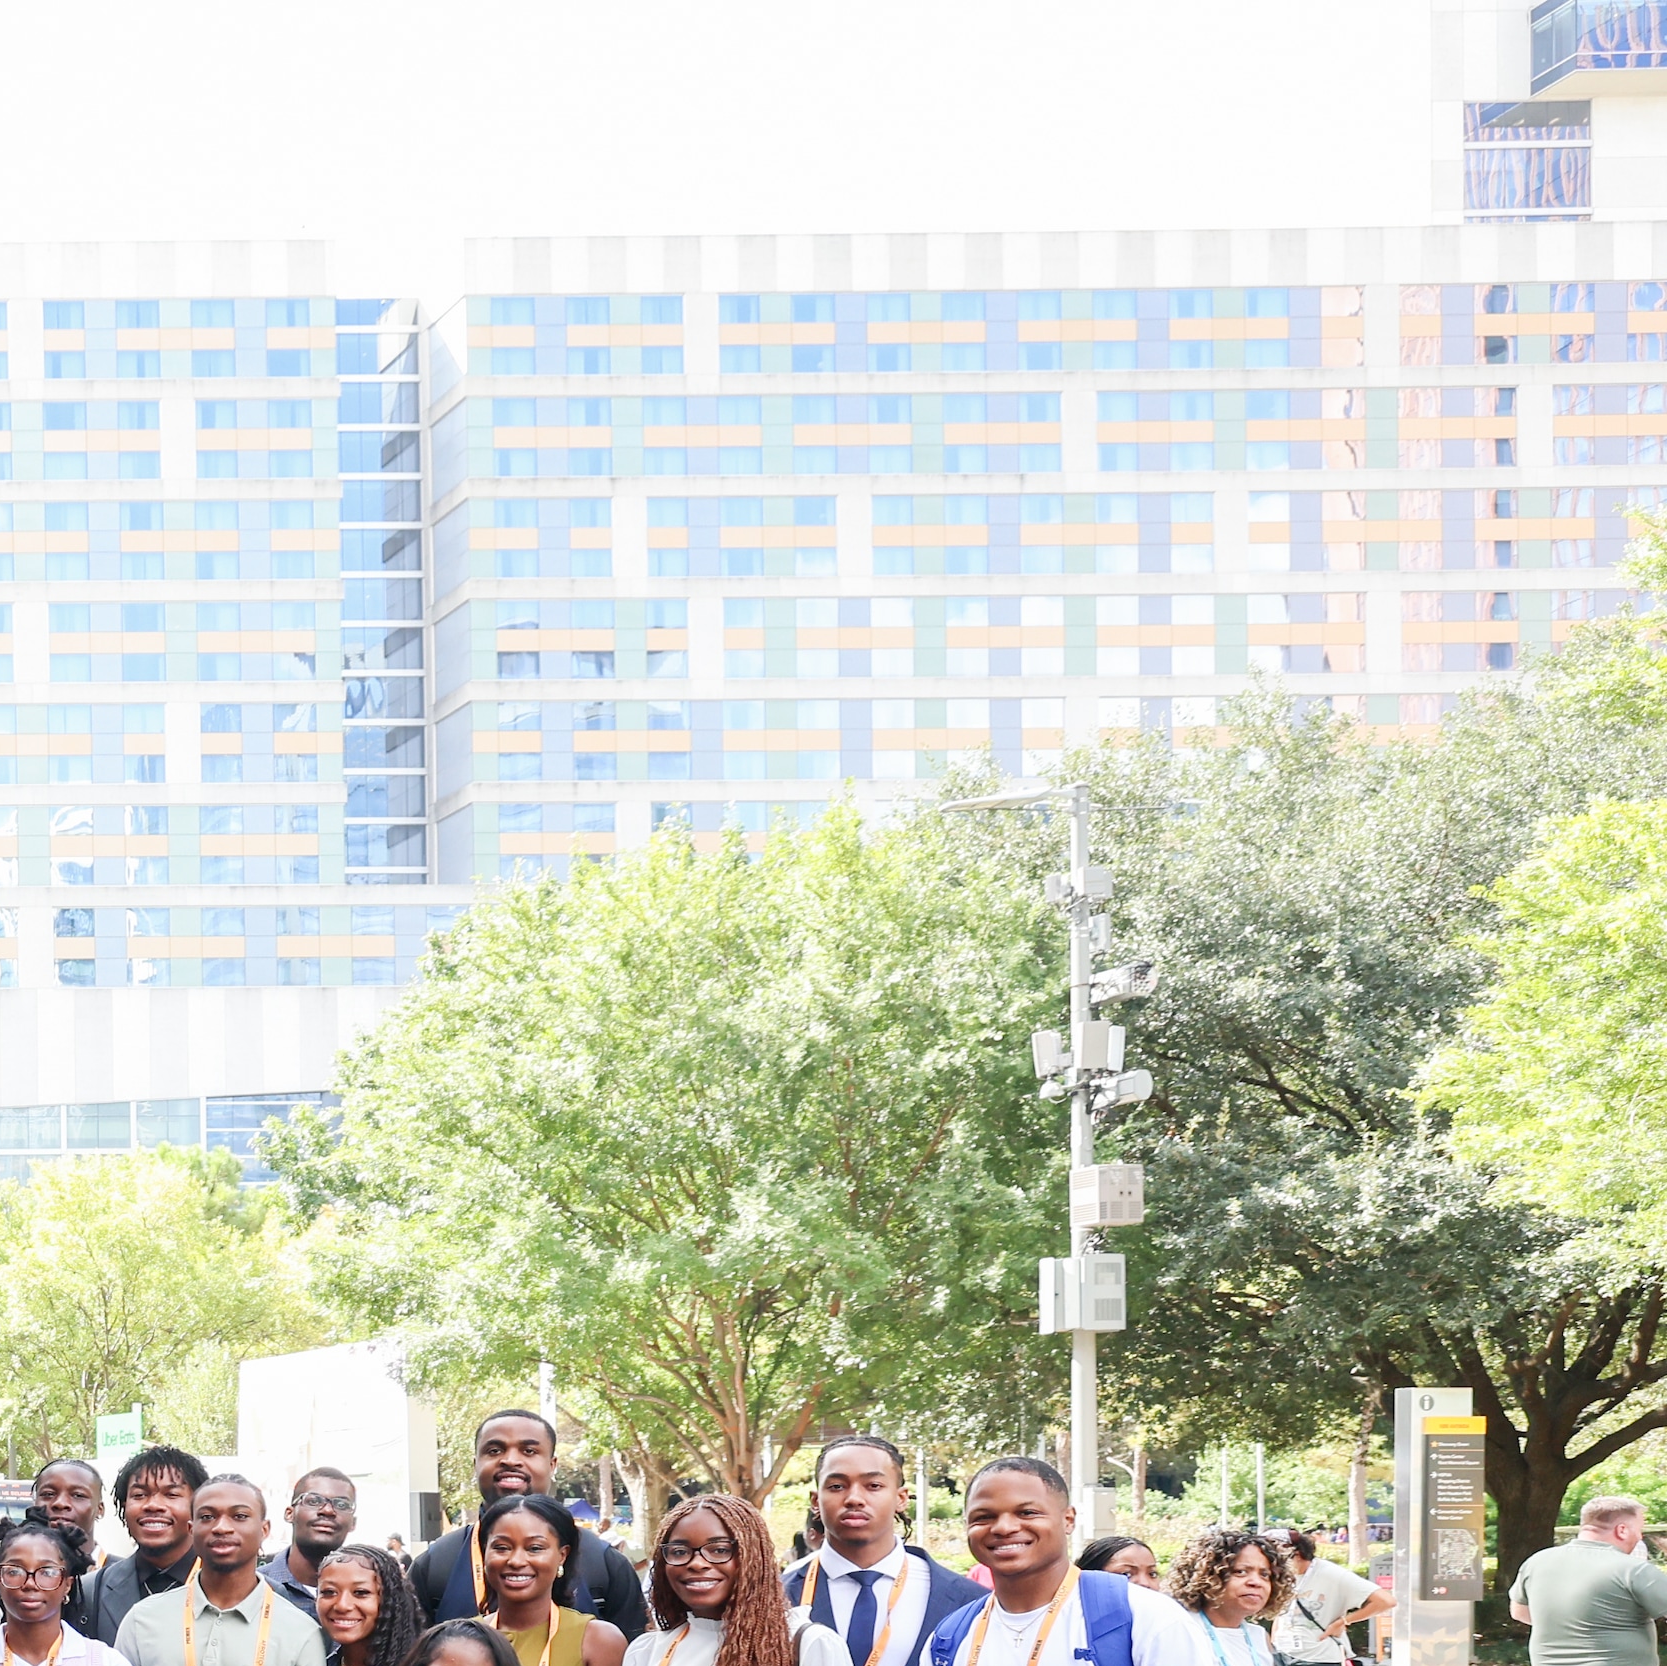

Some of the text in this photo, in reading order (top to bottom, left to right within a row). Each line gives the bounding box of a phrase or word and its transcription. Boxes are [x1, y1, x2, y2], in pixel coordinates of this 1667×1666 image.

[101, 1429, 136, 1447] Uber Eats
[1049, 1585, 1067, 1614] AFROTECH
[1031, 1639, 1043, 1661] PREMIER
